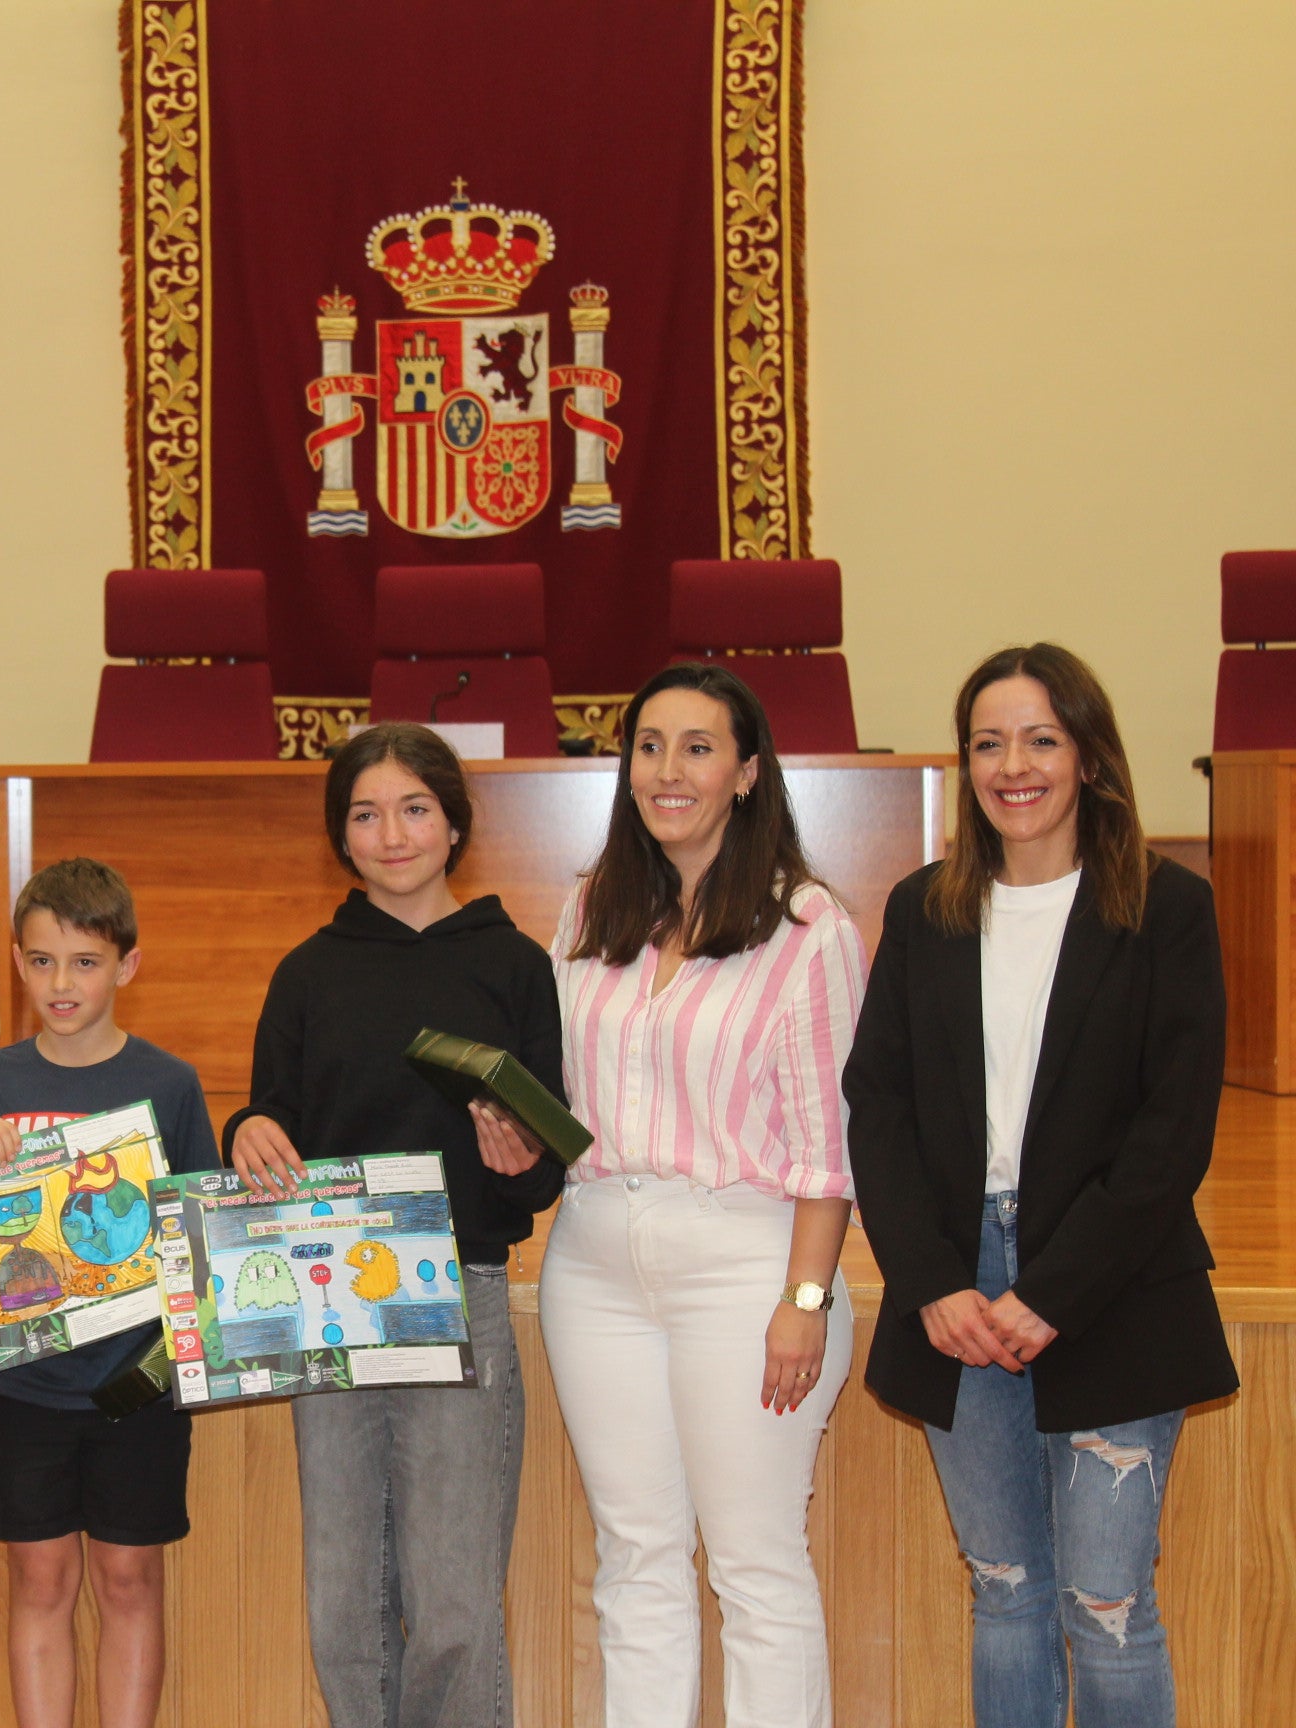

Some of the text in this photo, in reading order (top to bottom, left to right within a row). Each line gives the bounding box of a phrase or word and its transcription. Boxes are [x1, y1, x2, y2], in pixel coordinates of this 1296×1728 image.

[317, 377, 364, 397] PLVS
[557, 370, 615, 391] VLTRA
[163, 1242, 186, 1253] ecus
